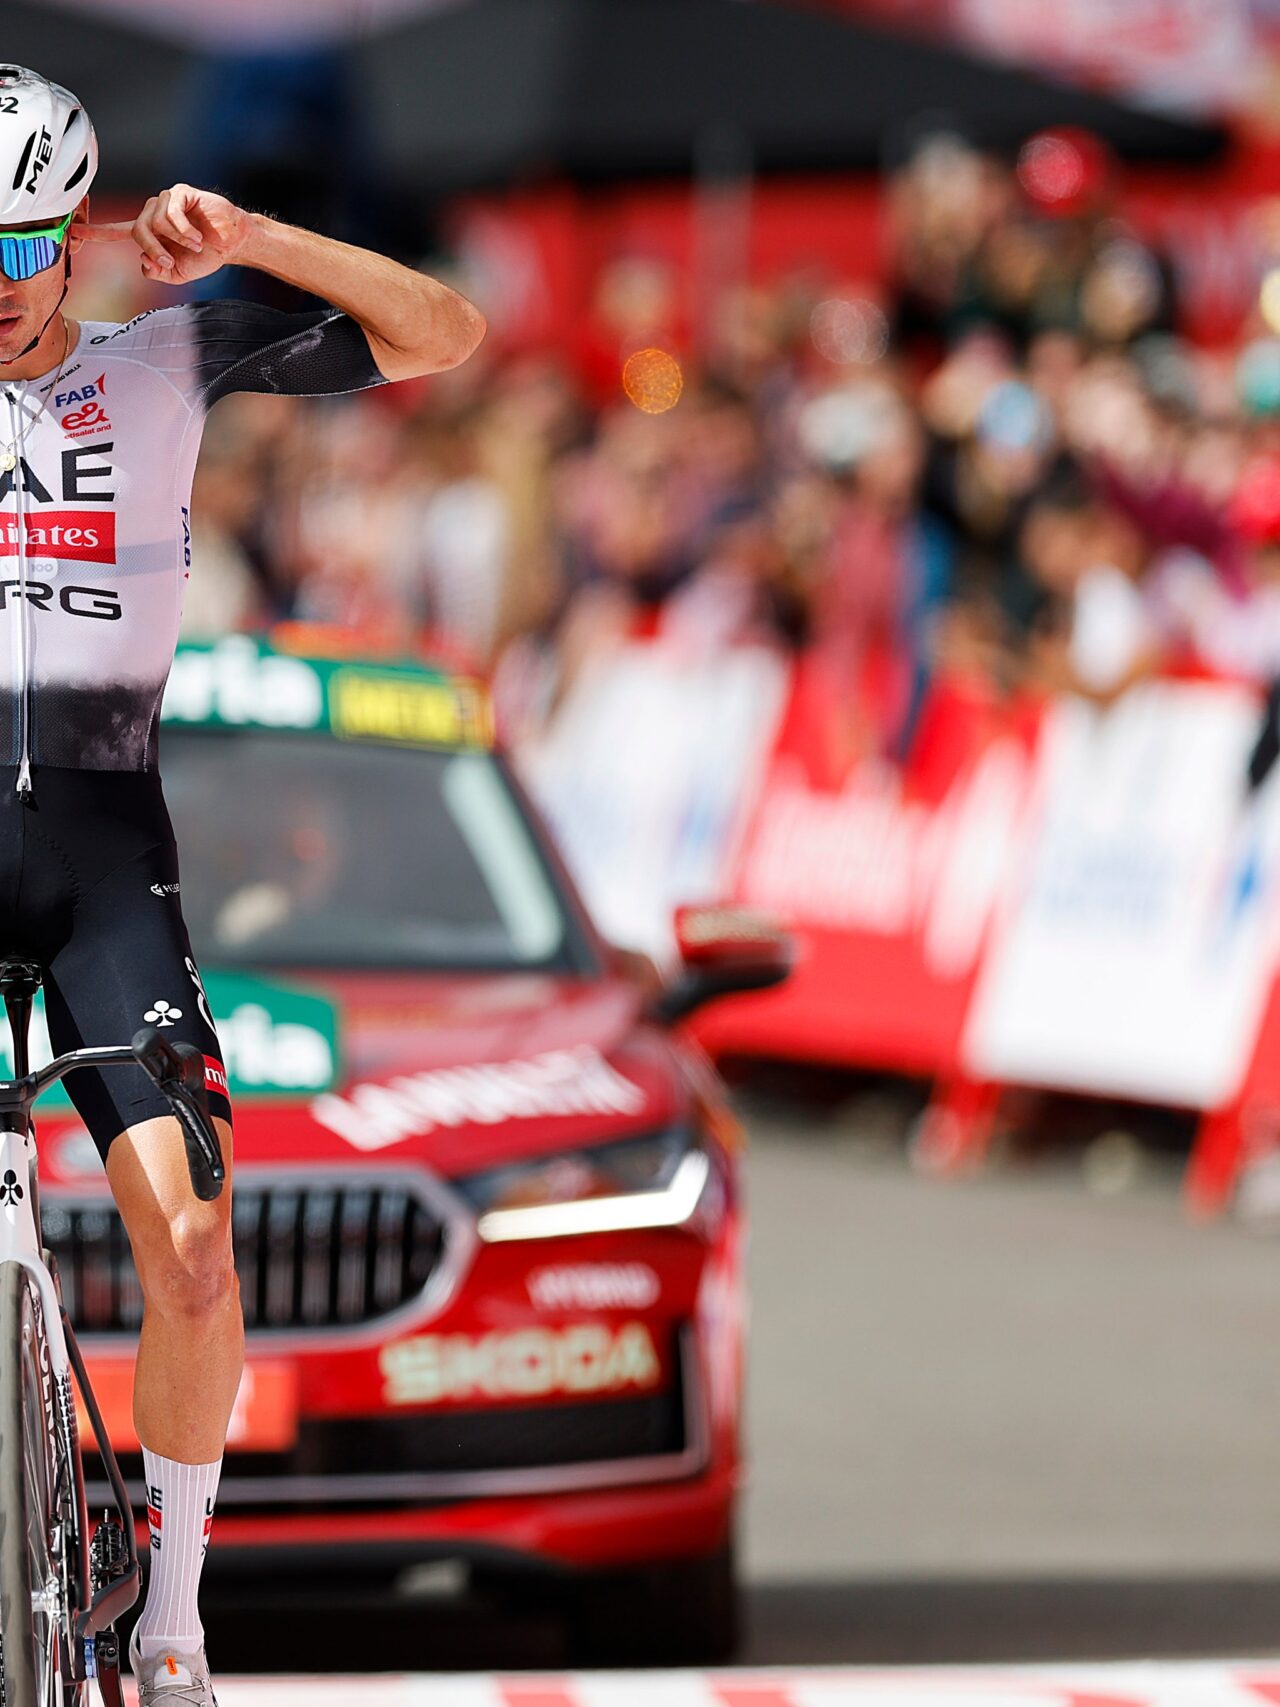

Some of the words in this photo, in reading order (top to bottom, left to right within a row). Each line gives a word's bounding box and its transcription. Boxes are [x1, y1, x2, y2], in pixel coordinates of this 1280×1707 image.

[25, 124, 52, 195] MET
[54, 384, 97, 408] FAB
[64, 427, 95, 440] etisalat
[96, 423, 112, 434] and
